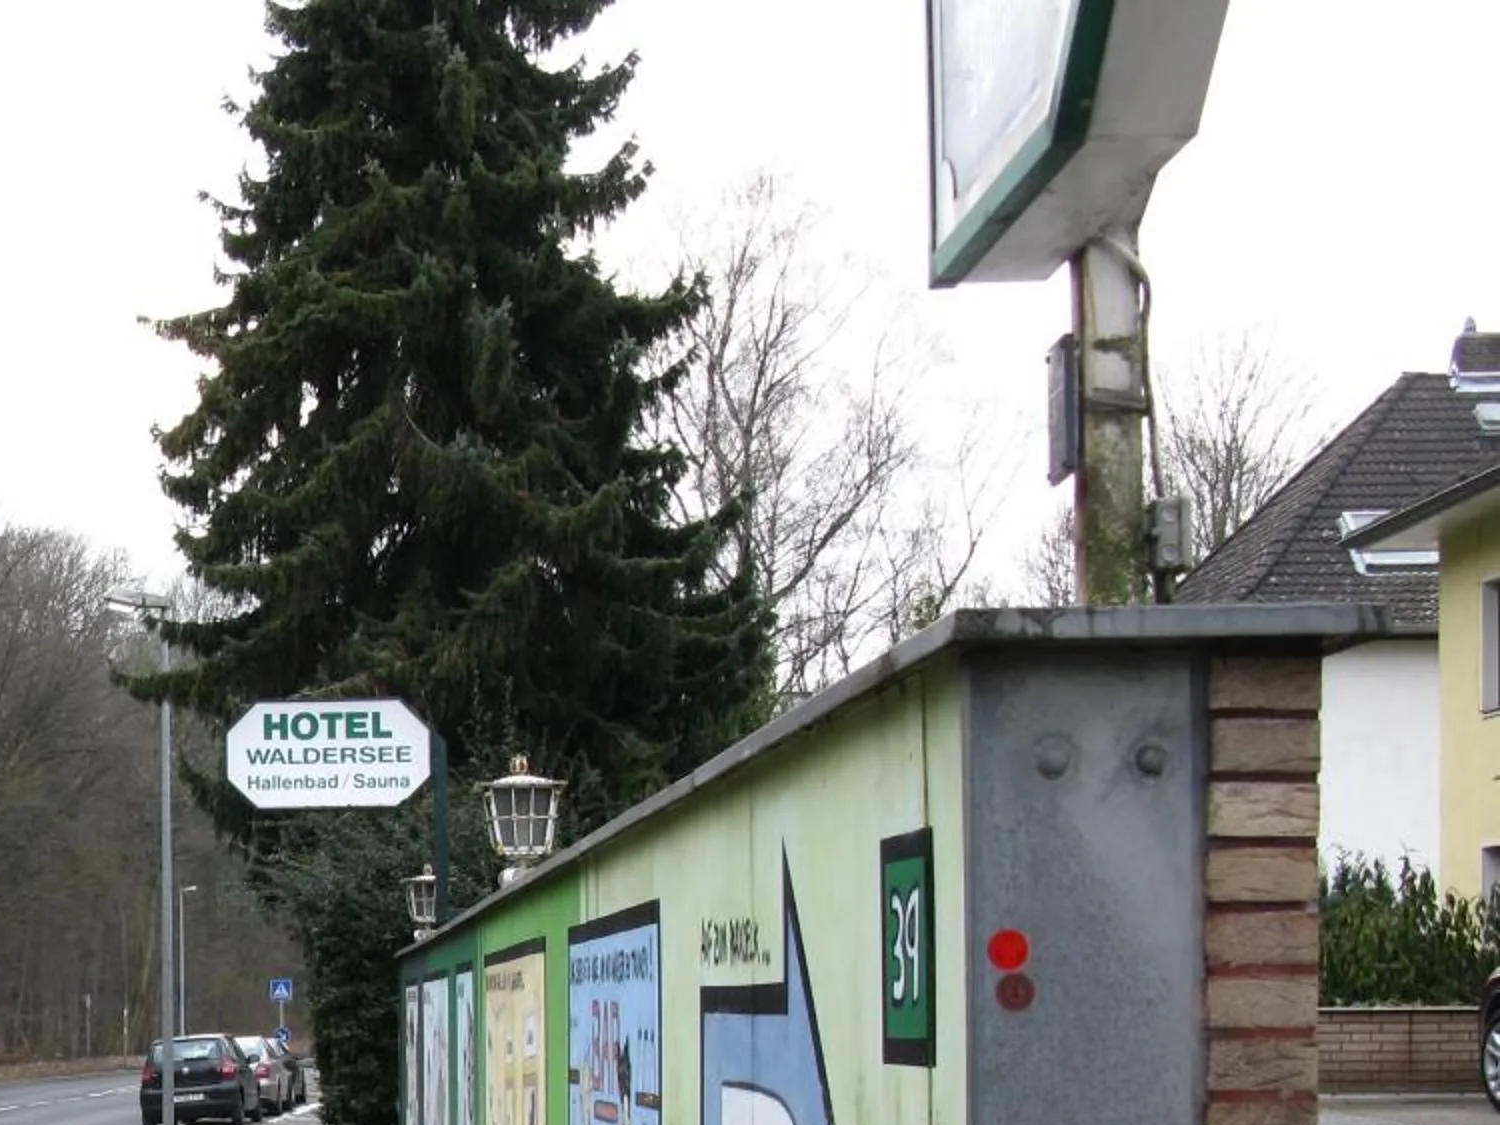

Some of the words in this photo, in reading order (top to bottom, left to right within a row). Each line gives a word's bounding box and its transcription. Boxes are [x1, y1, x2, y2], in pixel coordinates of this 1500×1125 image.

[263, 711, 393, 740] HOTEL
[246, 745, 413, 765] WALDERSEE
[247, 774, 339, 791] Hallenbad
[353, 773, 411, 789] Sauna
[891, 885, 920, 1002] 39
